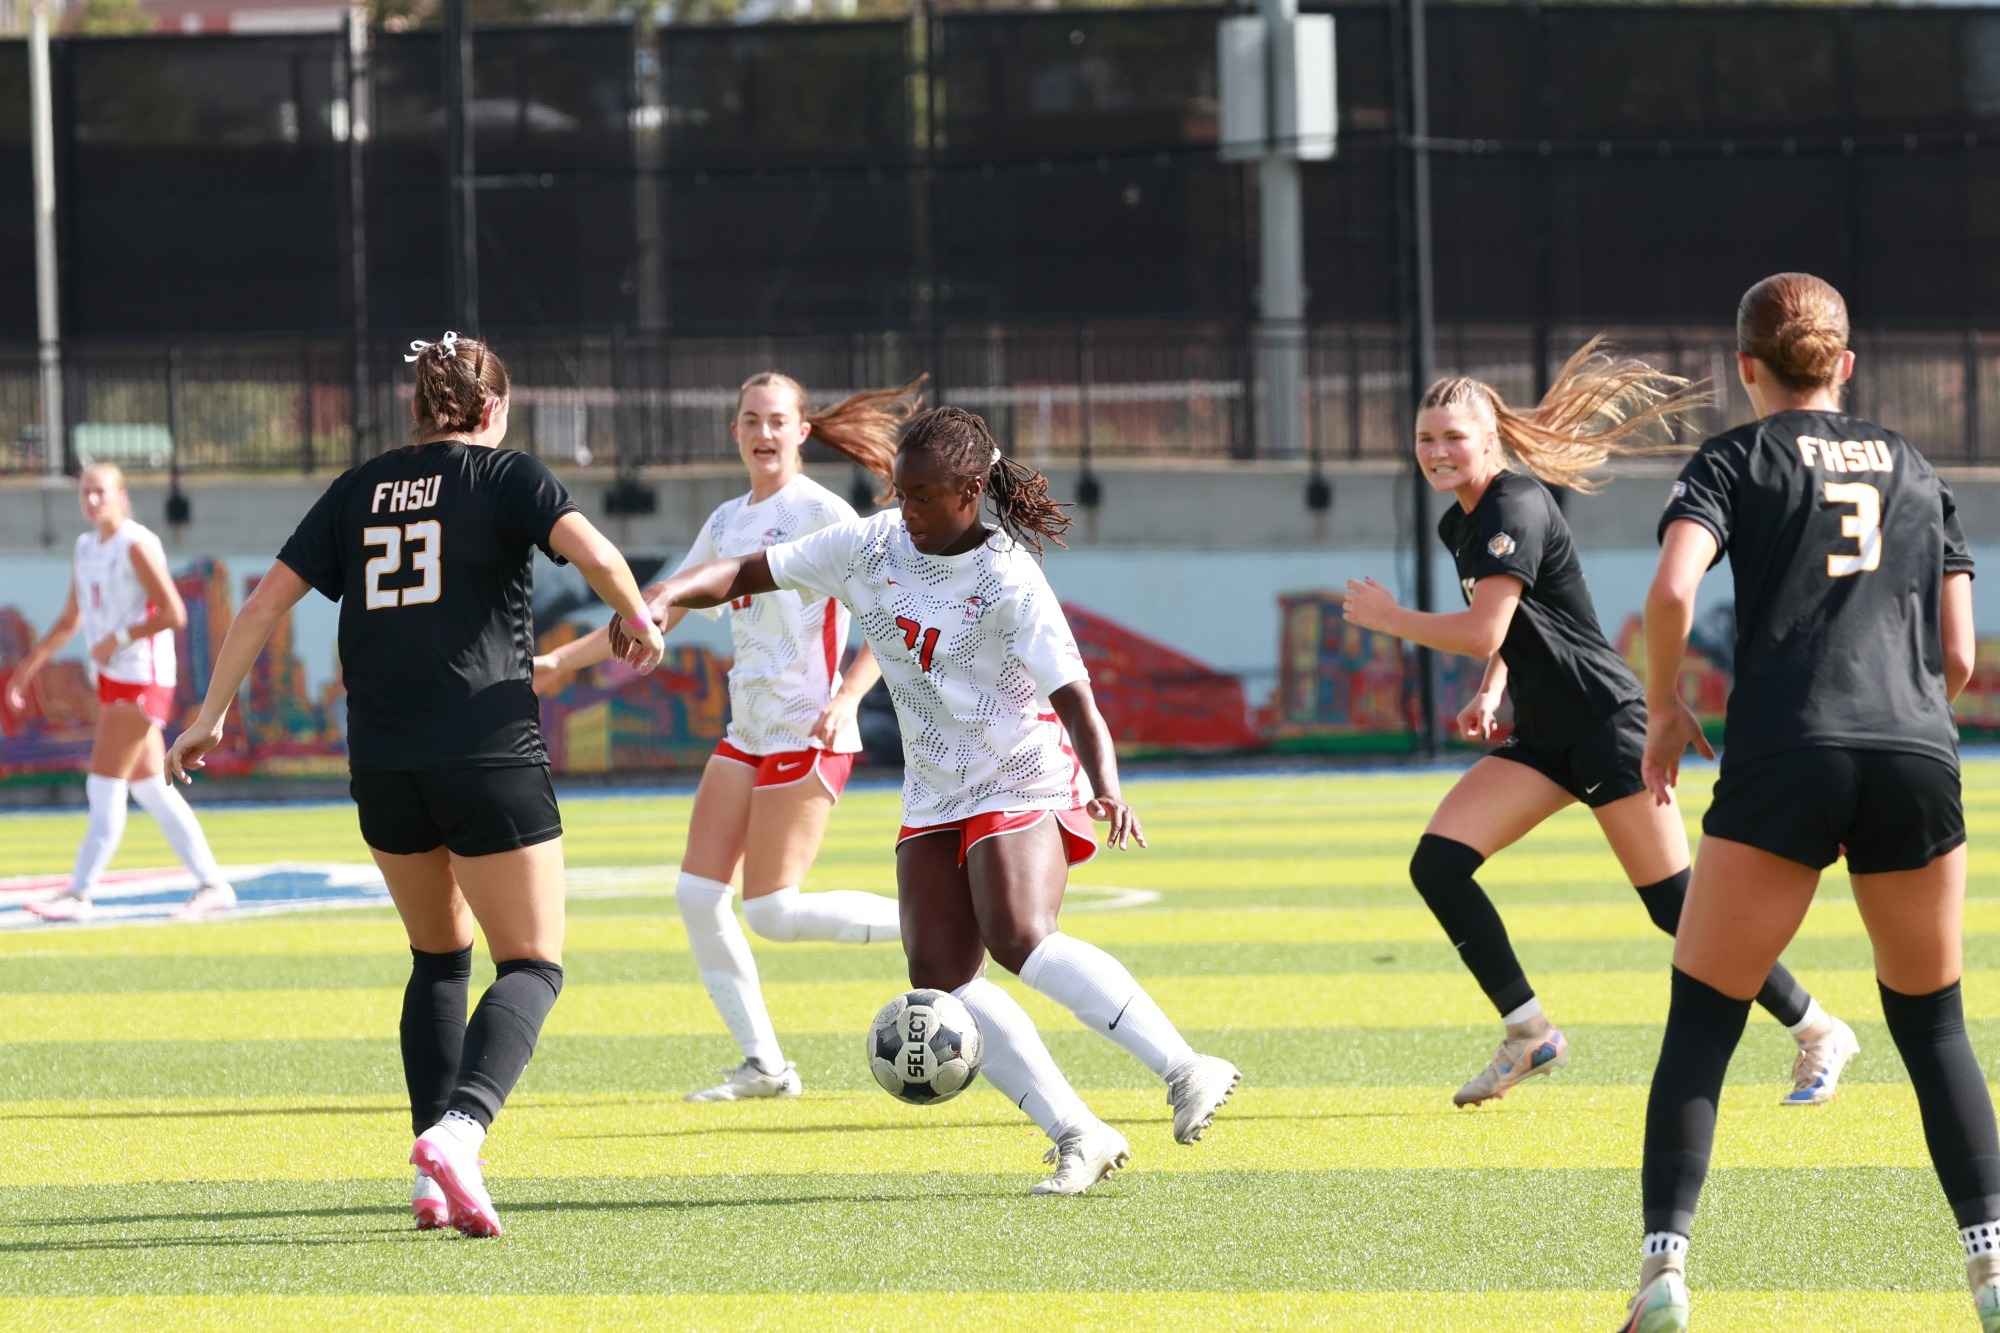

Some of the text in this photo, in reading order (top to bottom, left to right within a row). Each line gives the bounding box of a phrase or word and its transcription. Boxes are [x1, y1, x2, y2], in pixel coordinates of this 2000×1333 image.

[1797, 435, 1893, 473] FHSU
[371, 475, 443, 513] FHSU
[1824, 482, 1882, 577] 3
[363, 520, 441, 610] 23
[907, 1011, 928, 1078] SELECT
